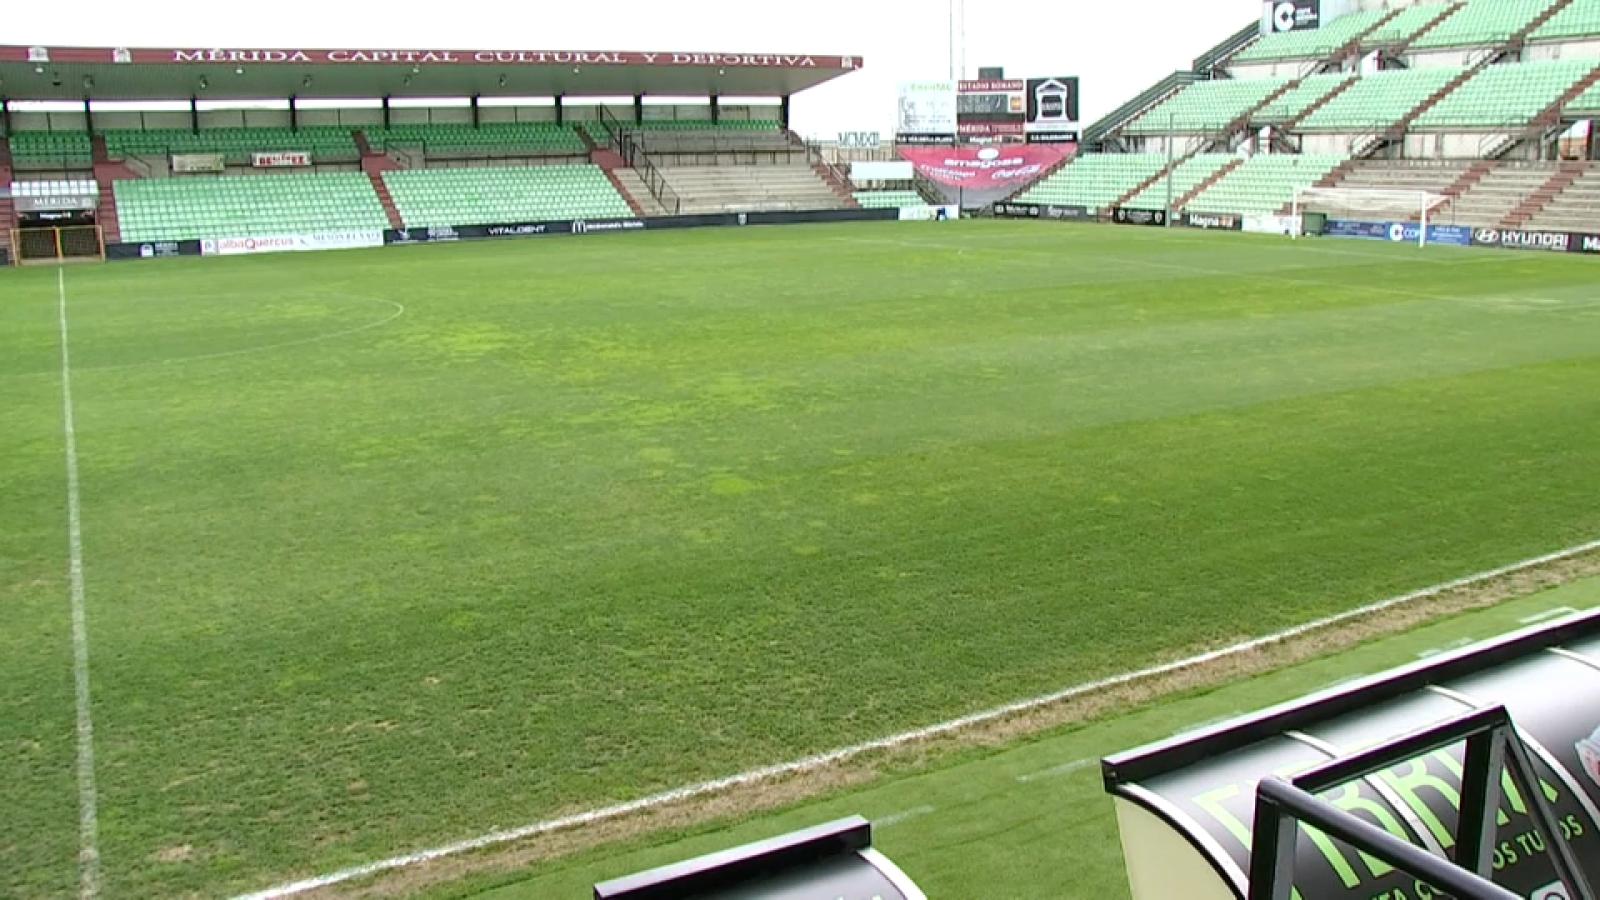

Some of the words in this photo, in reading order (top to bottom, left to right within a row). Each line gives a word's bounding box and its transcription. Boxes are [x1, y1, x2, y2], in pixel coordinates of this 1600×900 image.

[173, 47, 312, 62] MÉRIDA
[327, 50, 459, 62] CAPITAL
[474, 51, 627, 63] CULTURAL
[643, 53, 658, 64] Y
[672, 53, 815, 66] DEPORTIVA
[488, 224, 546, 236] VITALDENT
[1501, 230, 1568, 248] HYUNDAI
